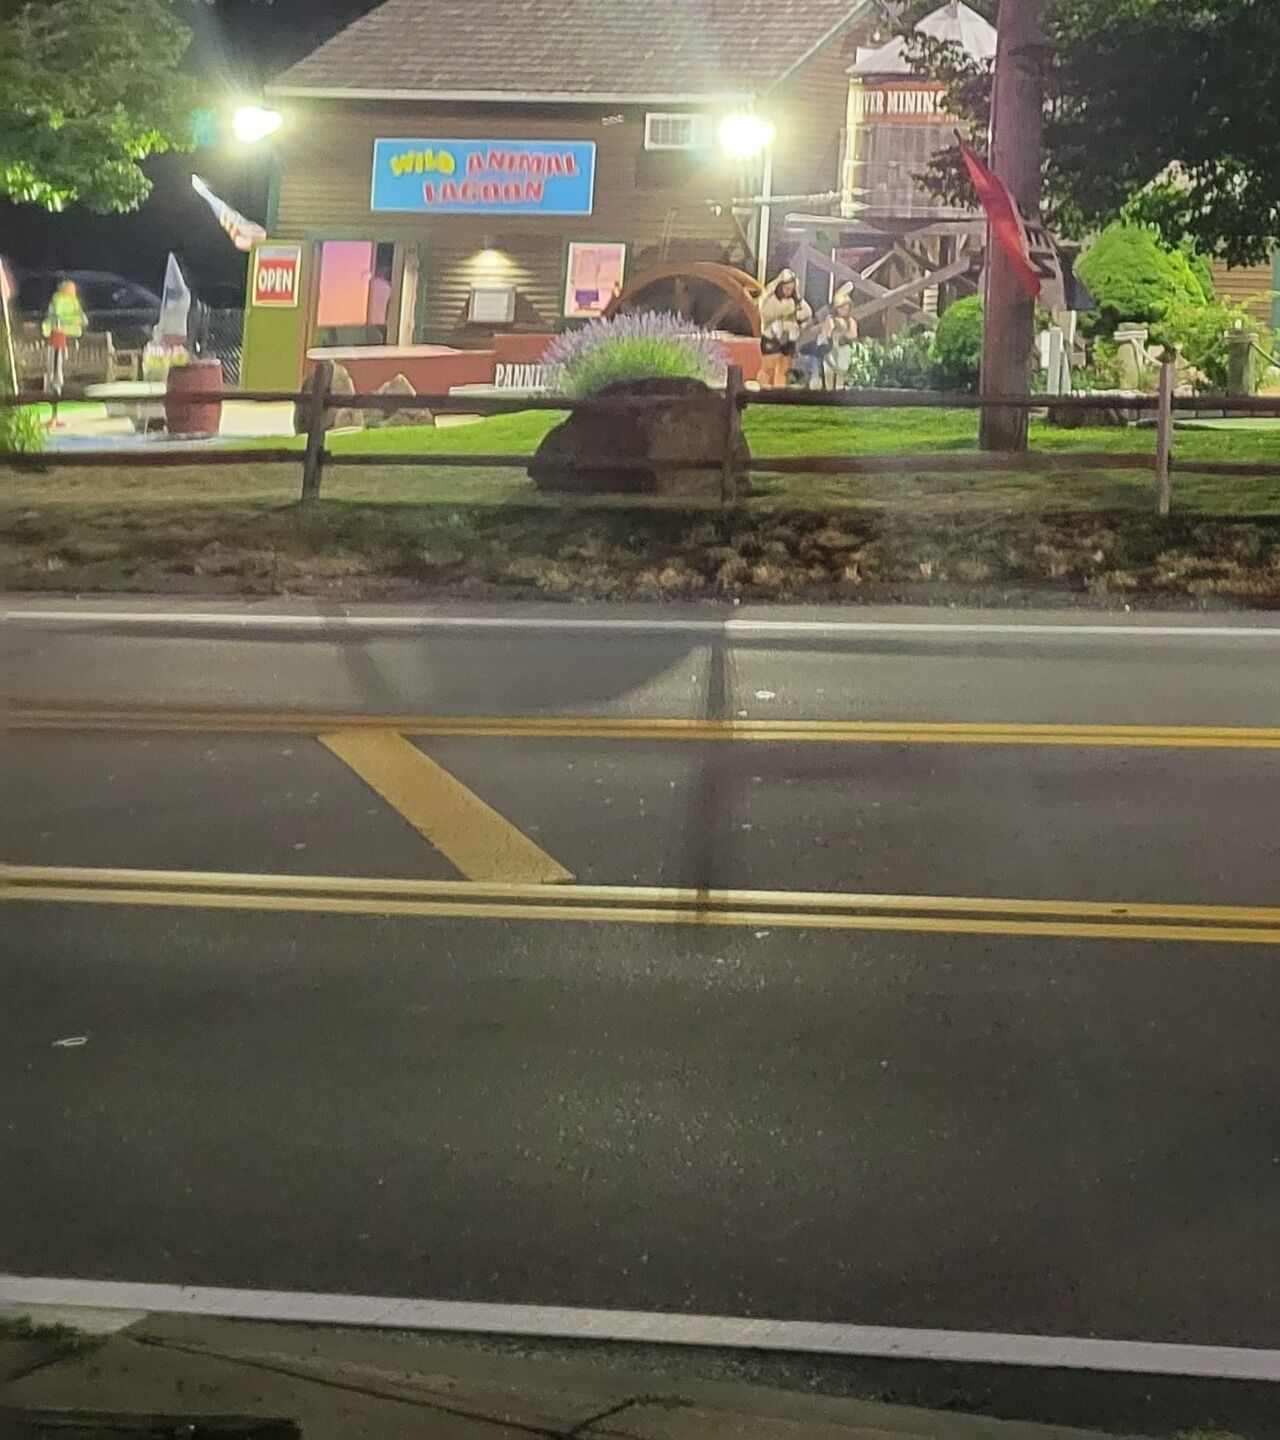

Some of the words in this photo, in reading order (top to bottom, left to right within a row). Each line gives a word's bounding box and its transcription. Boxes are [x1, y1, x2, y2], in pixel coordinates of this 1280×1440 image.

[390, 149, 456, 177] WILD
[467, 149, 578, 176] ANIMAL
[423, 179, 545, 204] LAGOON
[257, 266, 294, 294] OPEN
[494, 363, 553, 390] PANNI
